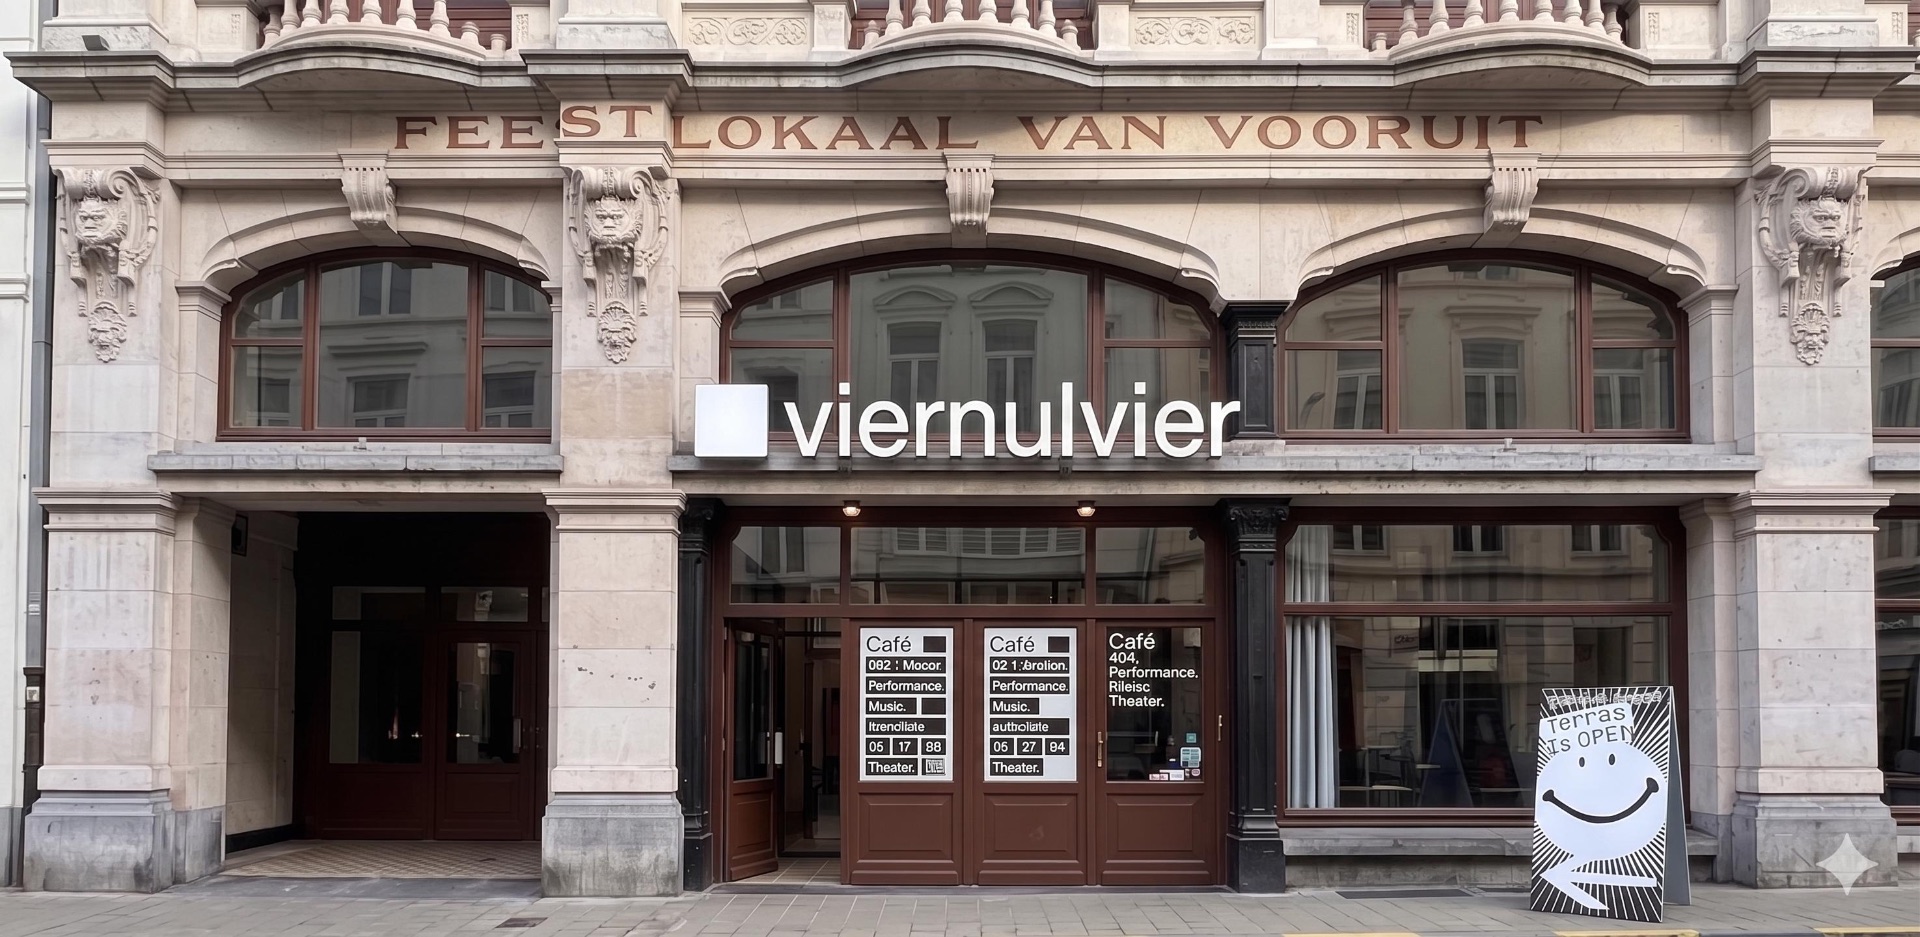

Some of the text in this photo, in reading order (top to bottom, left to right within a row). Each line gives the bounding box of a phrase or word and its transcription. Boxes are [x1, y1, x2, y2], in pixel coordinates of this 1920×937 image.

[1017, 115, 1168, 151] VAN
[1206, 114, 1543, 151] VOORUIT
[784, 382, 1241, 459] viernulvier
[866, 635, 912, 653] Café
[990, 635, 1035, 653] Café
[1108, 632, 1156, 650] Café
[992, 659, 1008, 671] 02
[1108, 665, 1199, 679] Performance.
[868, 679, 945, 692] Performance.
[992, 679, 1069, 692] Performance.
[868, 700, 907, 712] Music.
[992, 700, 1031, 712] Music.
[1108, 694, 1165, 707] Theater.
[1547, 707, 1626, 734] Terras
[1577, 725, 1635, 748] OPEN
[898, 741, 912, 753] 17
[1021, 741, 1037, 753] 27
[867, 761, 915, 773] Theater.
[992, 761, 1040, 774] Theater.
